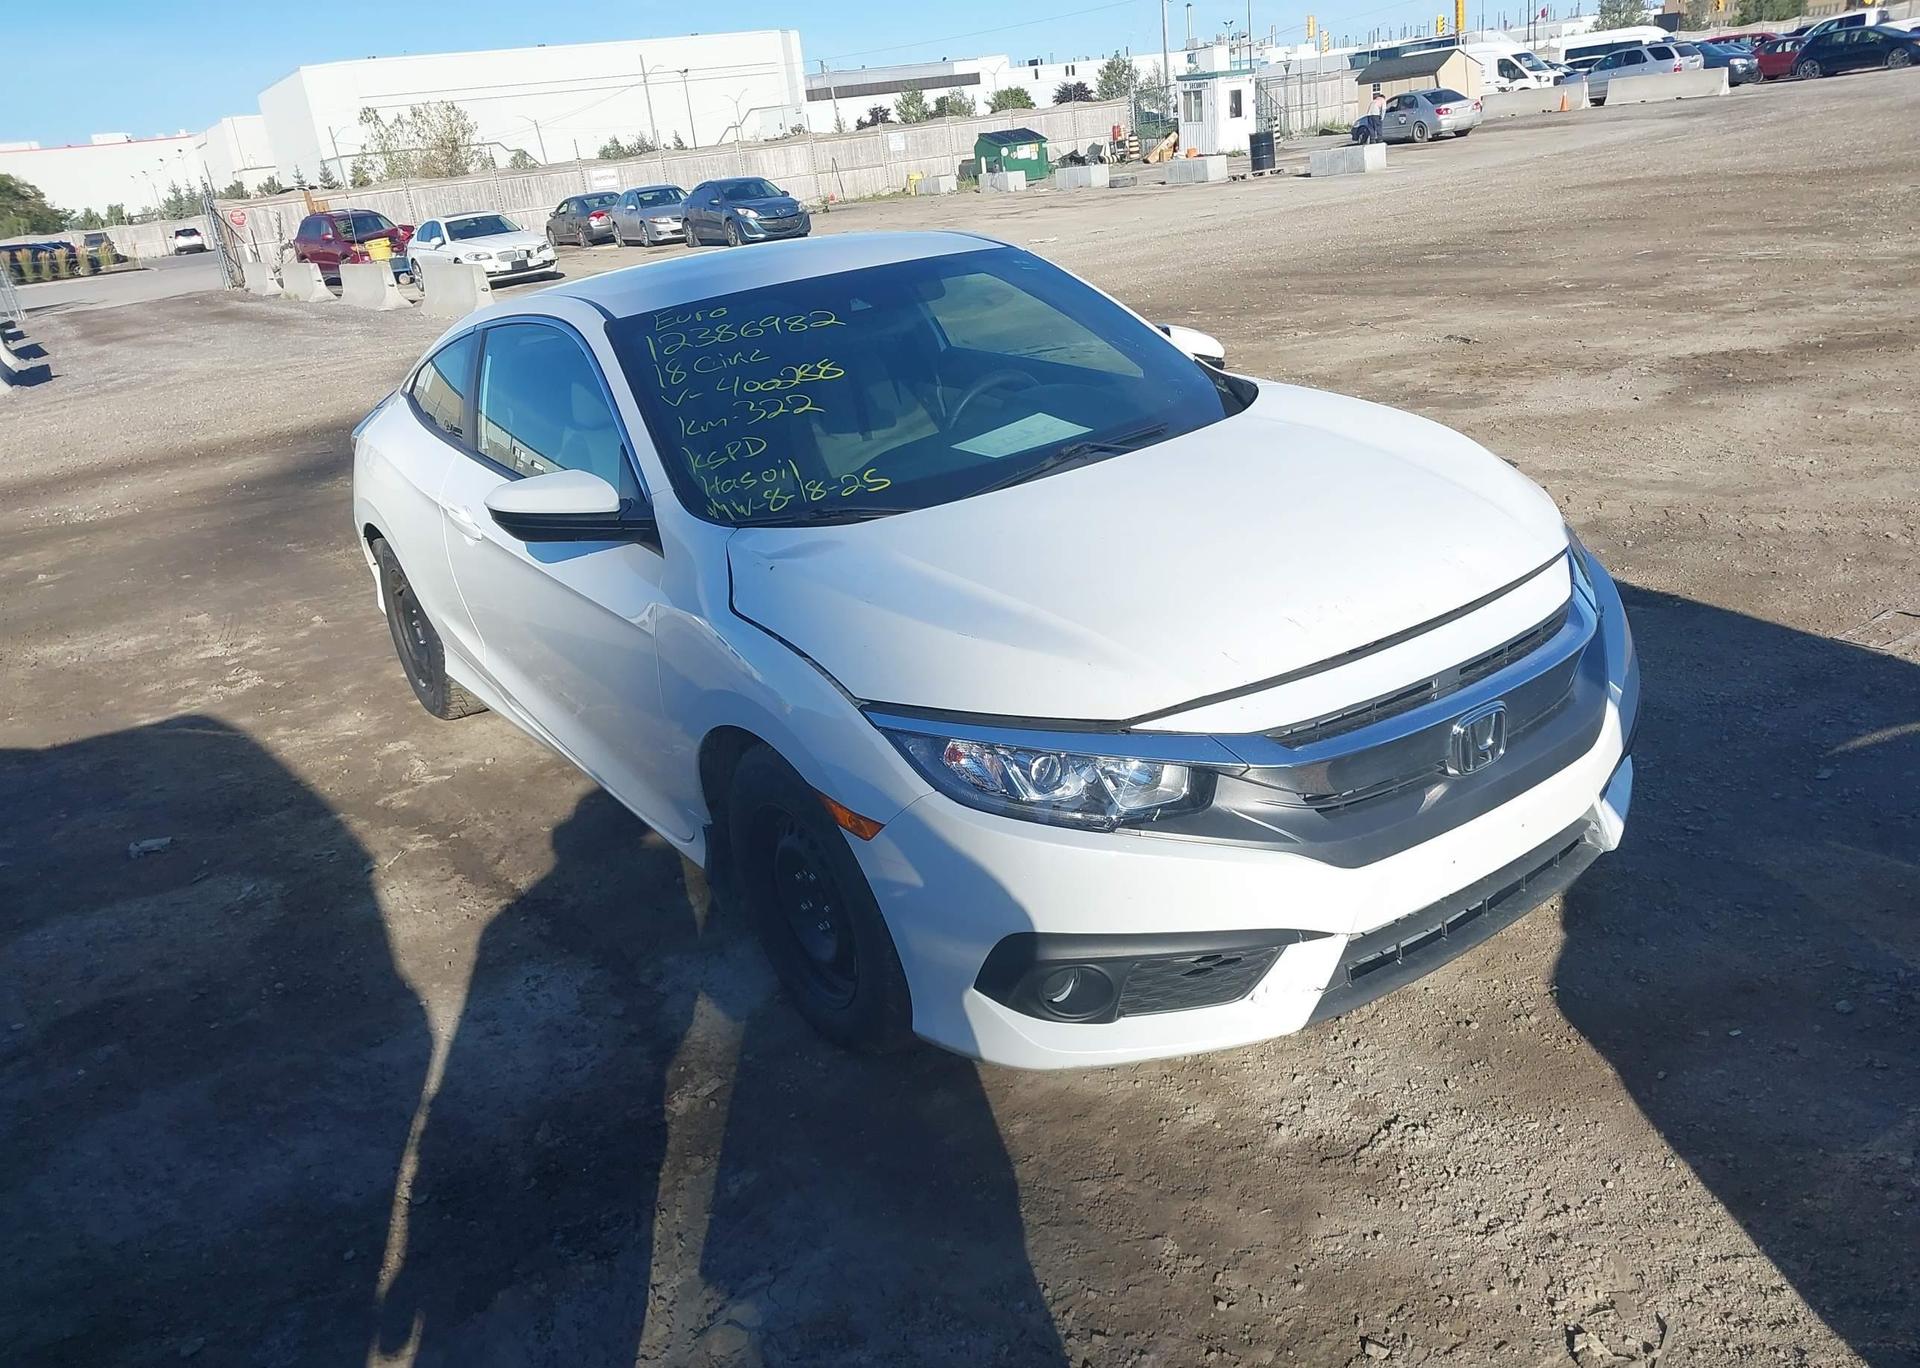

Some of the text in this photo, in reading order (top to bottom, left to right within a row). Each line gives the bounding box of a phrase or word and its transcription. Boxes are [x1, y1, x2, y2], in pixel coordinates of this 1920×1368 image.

[654, 307, 728, 331] Euro
[646, 310, 847, 362] 12386982
[654, 359, 687, 389] 18
